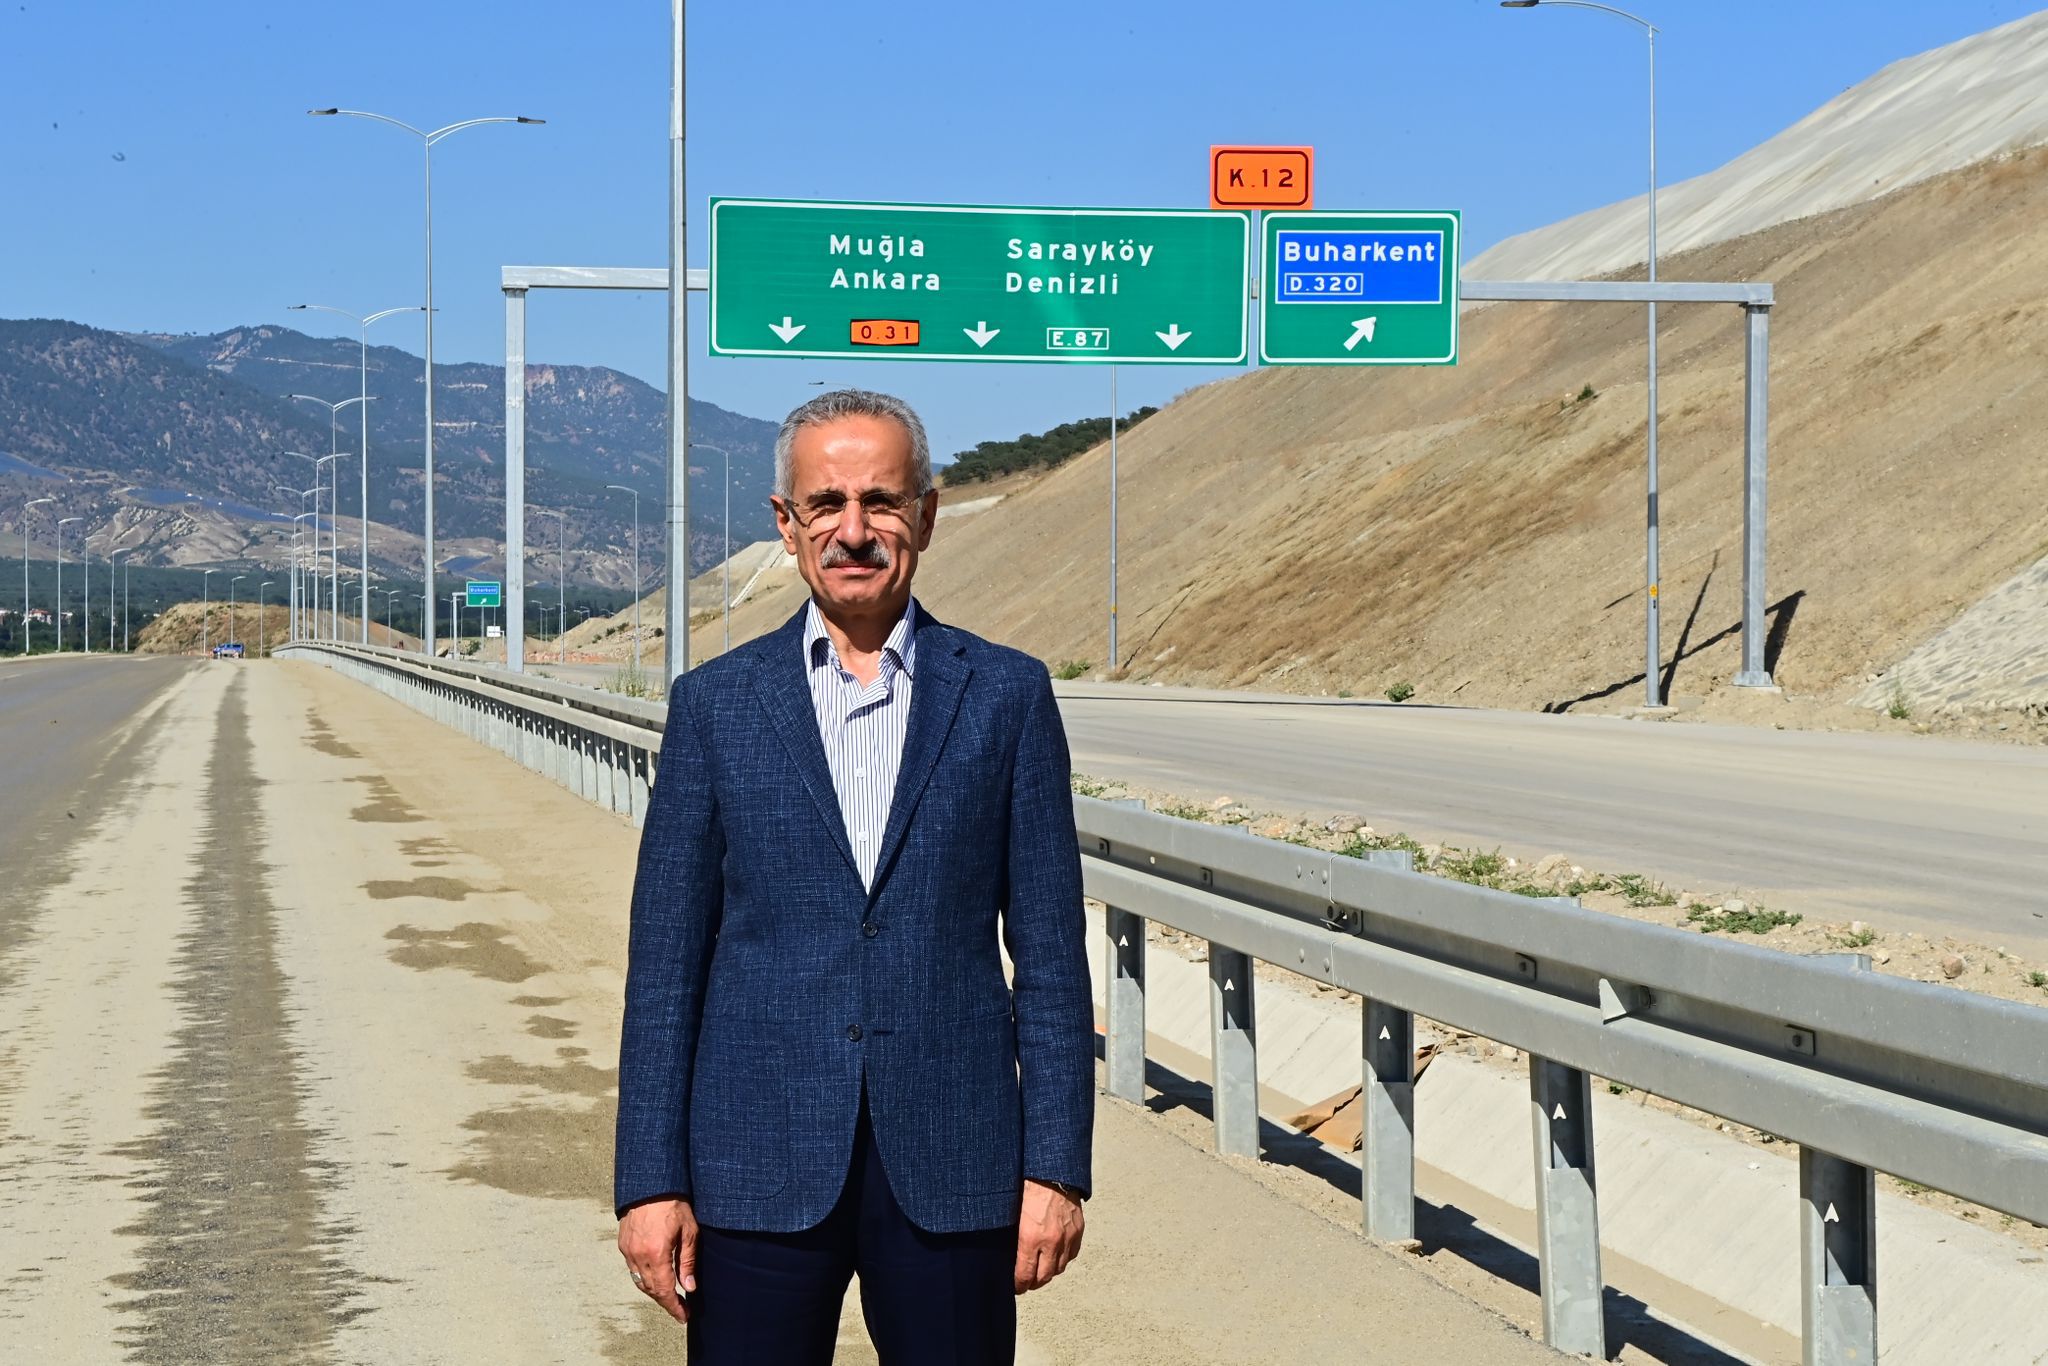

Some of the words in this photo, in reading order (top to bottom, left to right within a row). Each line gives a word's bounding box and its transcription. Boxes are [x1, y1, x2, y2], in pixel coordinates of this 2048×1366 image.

[1229, 168, 1293, 188] K.12
[829, 235, 925, 263] Muğla
[1007, 239, 1154, 267] Sarayköy
[1284, 241, 1435, 262] Buharkent
[830, 268, 940, 291] Ankara
[1006, 273, 1118, 295] Denizli
[1290, 276, 1358, 292] D.320
[1052, 331, 1104, 347] E.87
